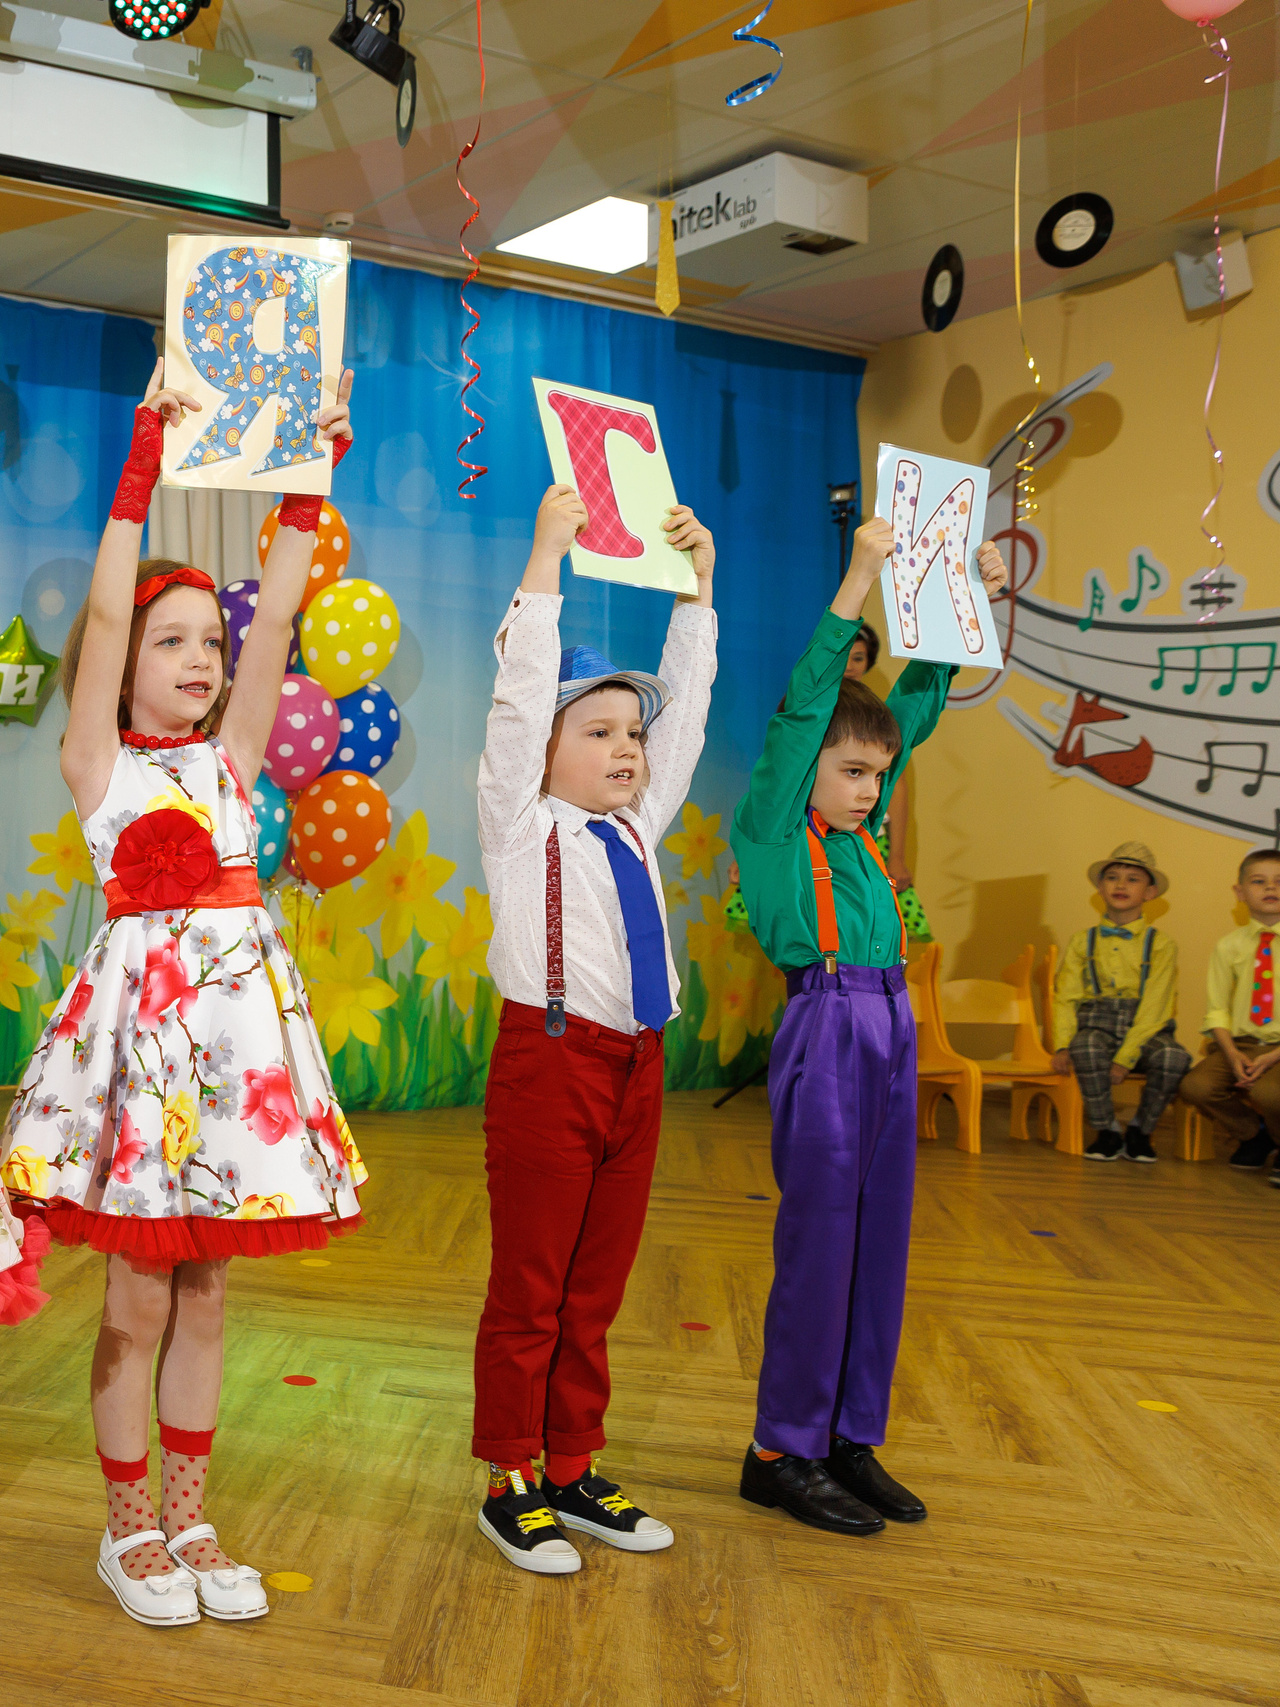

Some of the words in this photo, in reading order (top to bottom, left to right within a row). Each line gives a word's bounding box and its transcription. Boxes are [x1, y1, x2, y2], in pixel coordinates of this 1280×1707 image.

[733, 194, 757, 219] lab
[173, 244, 343, 478] Я
[548, 389, 657, 558] Г
[891, 459, 984, 654] И
